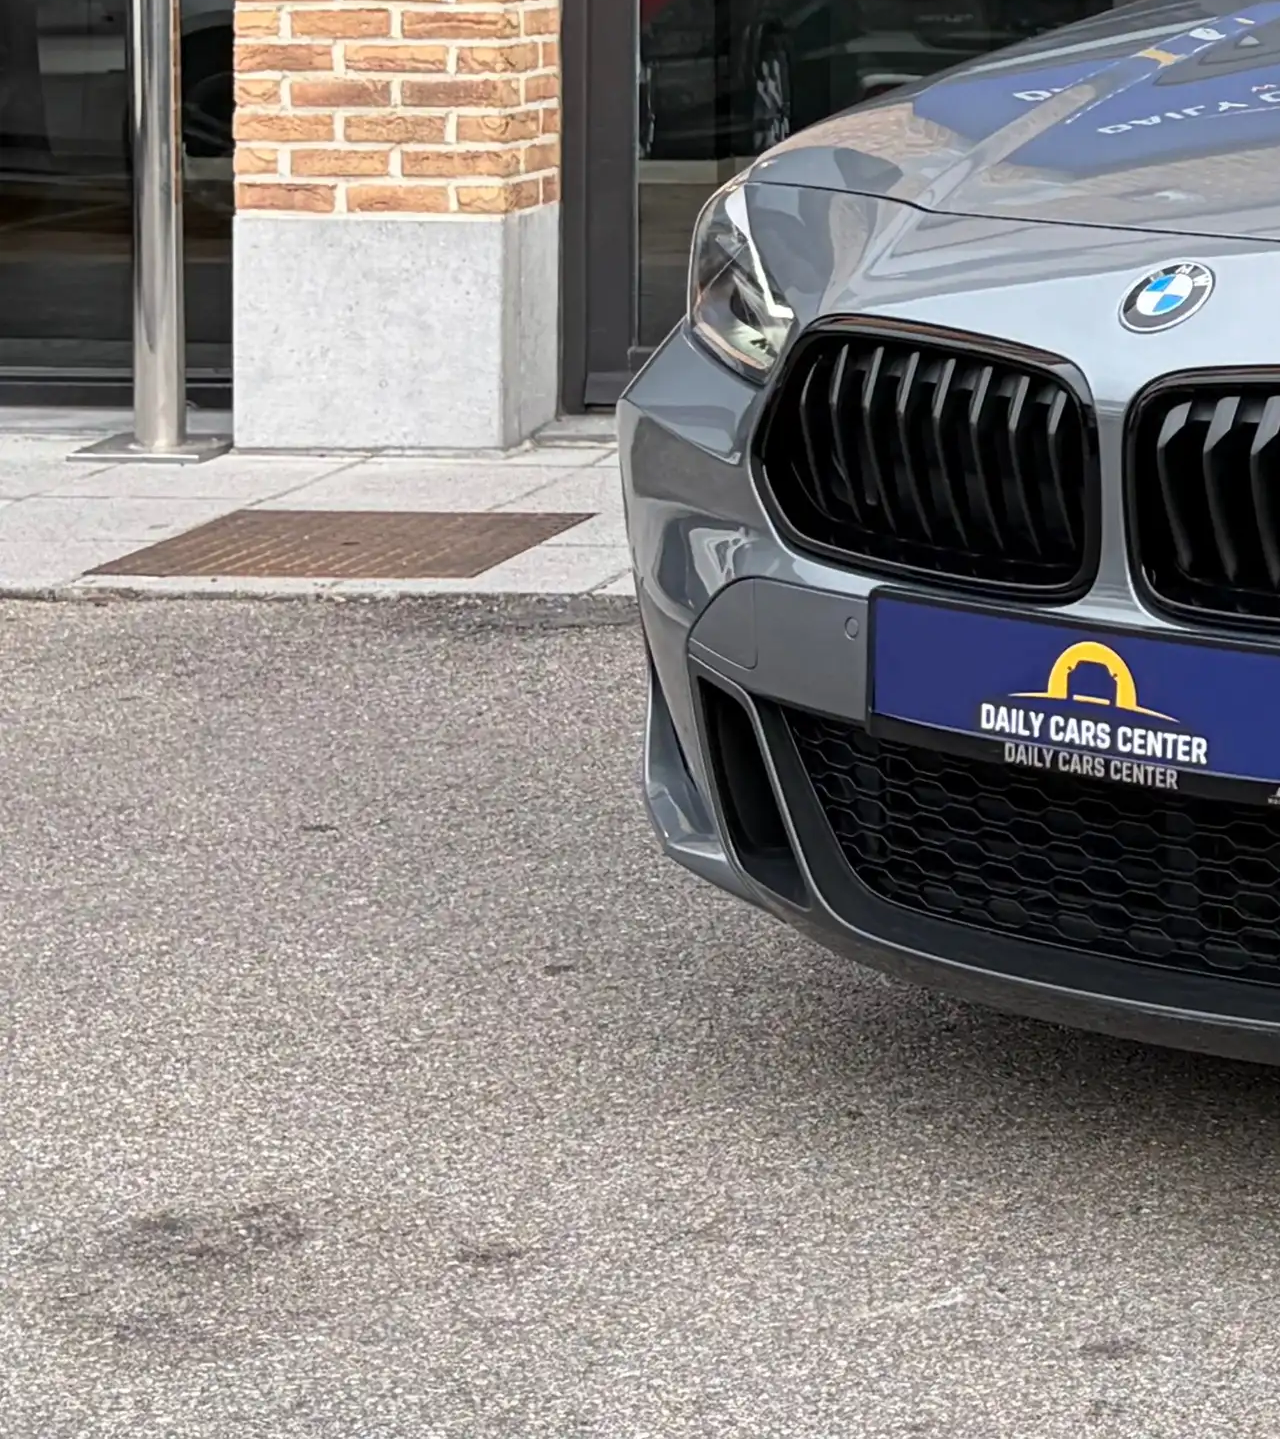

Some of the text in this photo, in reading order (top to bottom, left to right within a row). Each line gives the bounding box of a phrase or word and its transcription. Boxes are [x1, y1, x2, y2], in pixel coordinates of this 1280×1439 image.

[981, 702, 1208, 765] DAILY CARS CENTER
[1004, 741, 1178, 790] DAILY CARS CENTER
